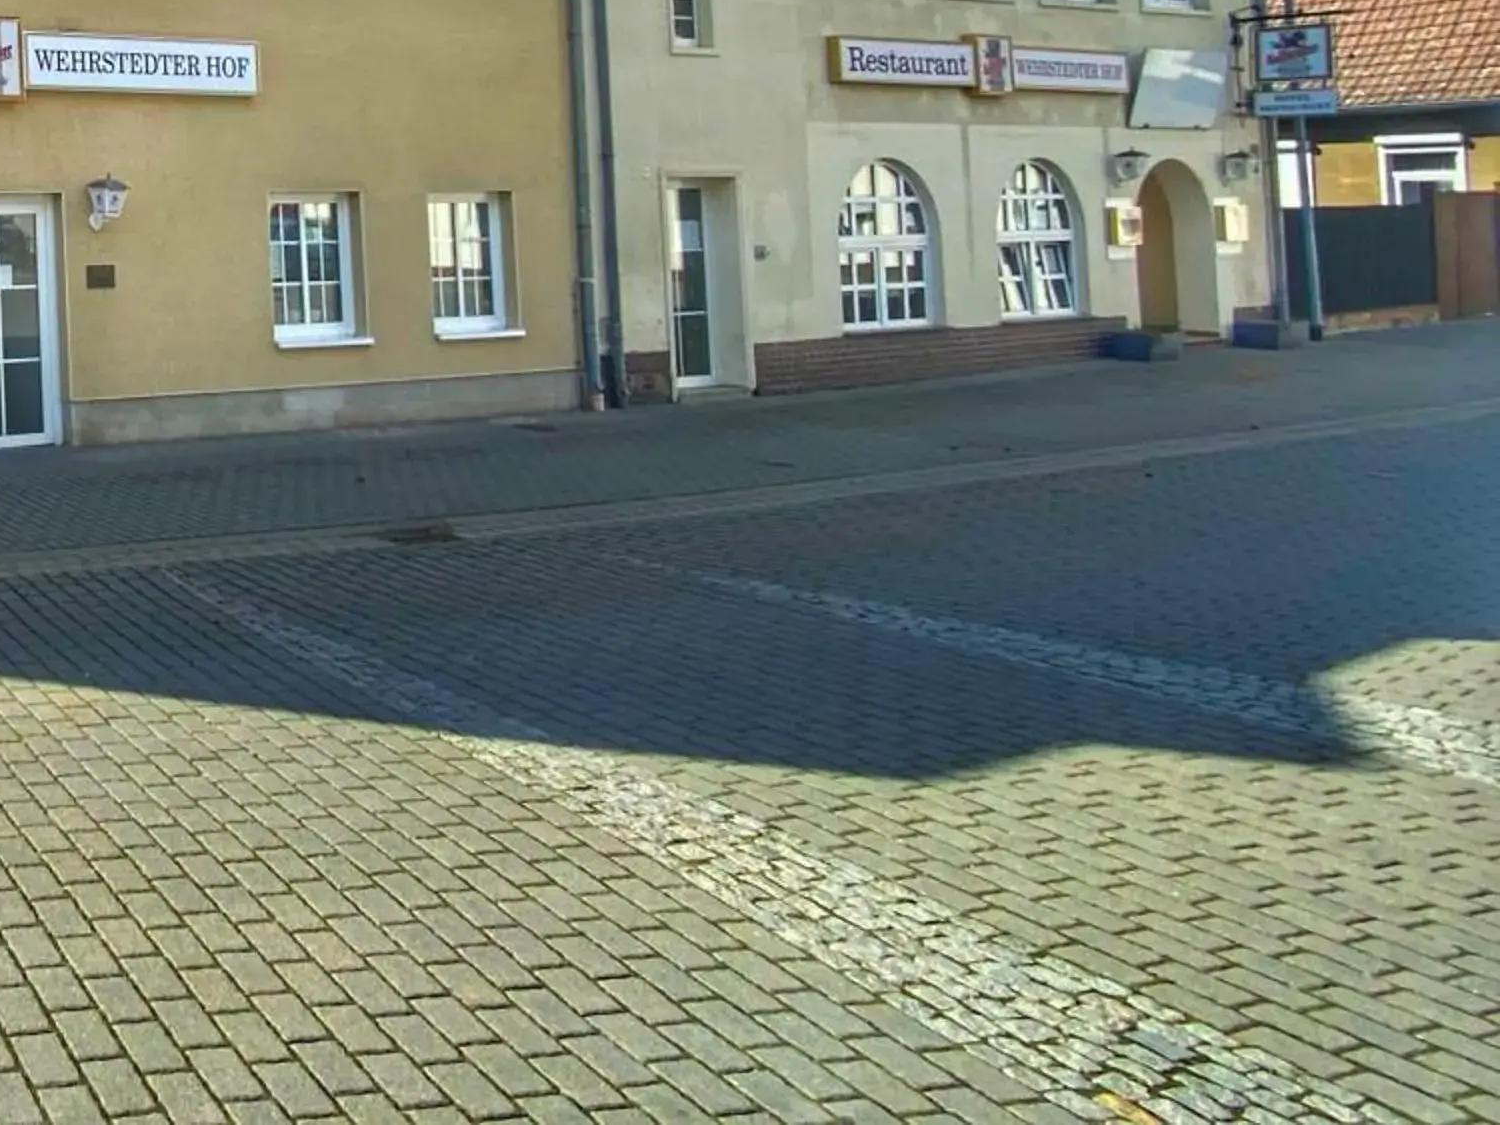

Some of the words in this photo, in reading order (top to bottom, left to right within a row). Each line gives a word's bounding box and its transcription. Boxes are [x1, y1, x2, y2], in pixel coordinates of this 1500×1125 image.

[34, 48, 201, 77] WEHRSTEDTER
[205, 55, 250, 79] HOF
[847, 46, 970, 76] Restaurant
